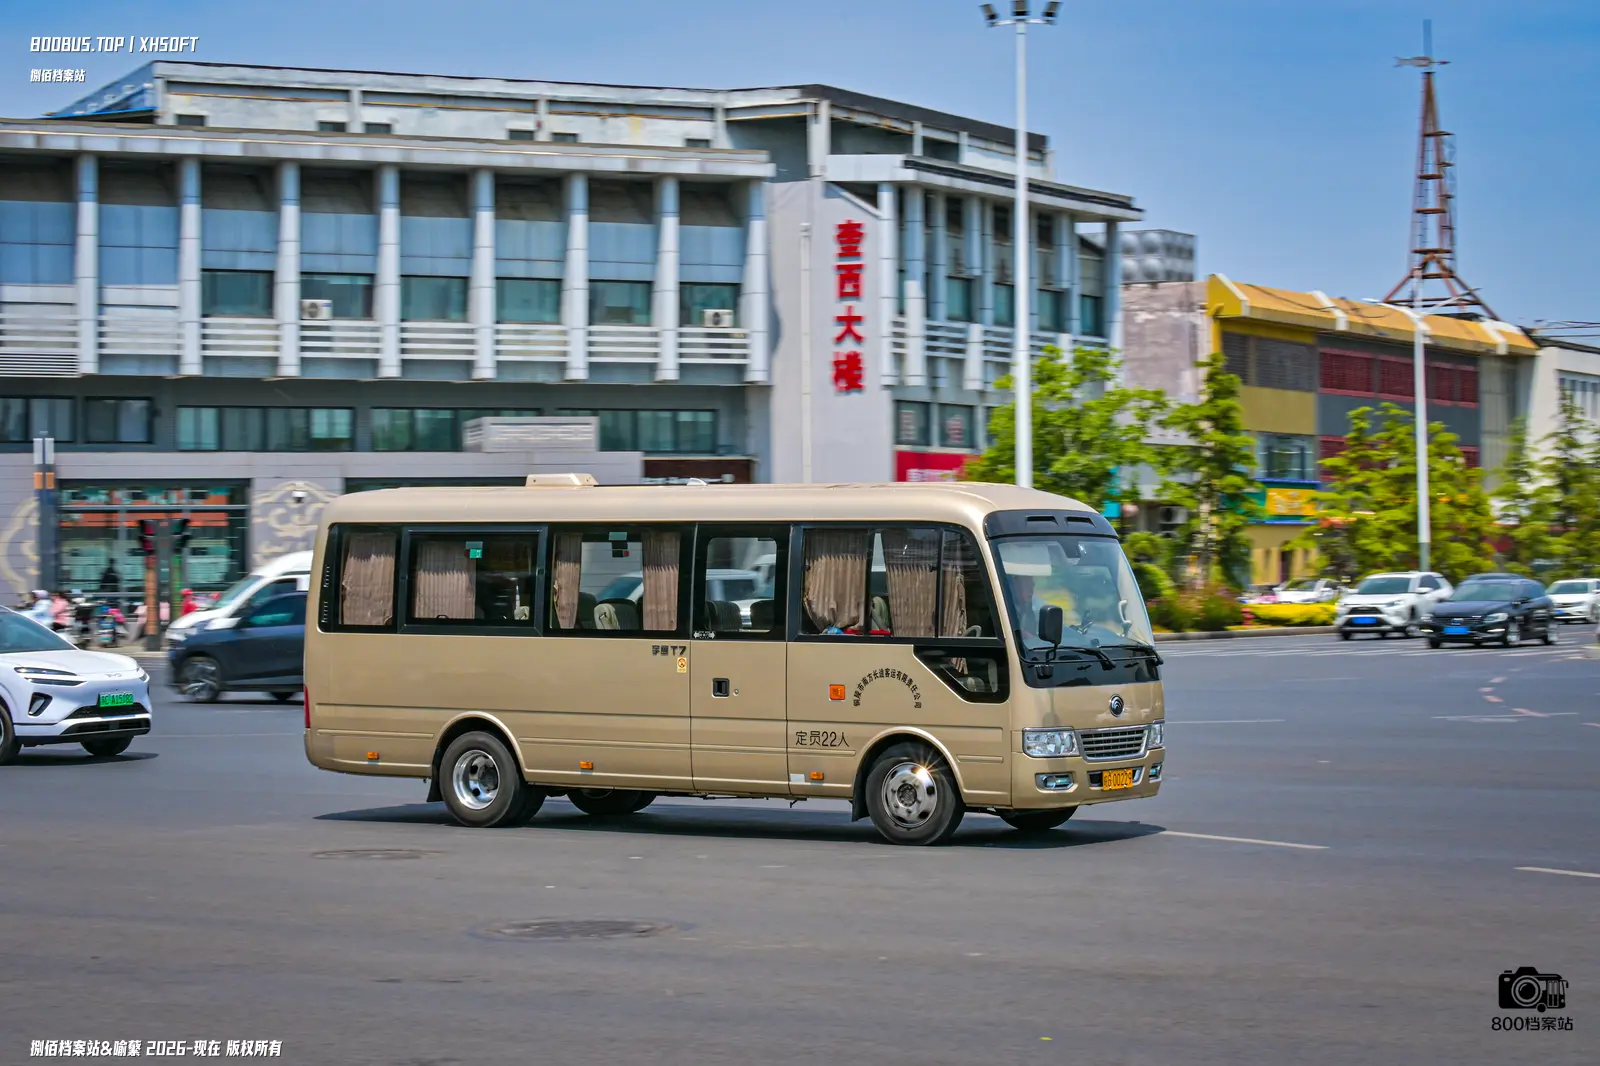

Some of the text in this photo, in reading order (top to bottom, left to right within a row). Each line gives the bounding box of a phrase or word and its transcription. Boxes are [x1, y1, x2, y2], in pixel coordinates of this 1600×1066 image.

[670, 645, 687, 656] T7
[795, 731, 849, 747] 定员22人
